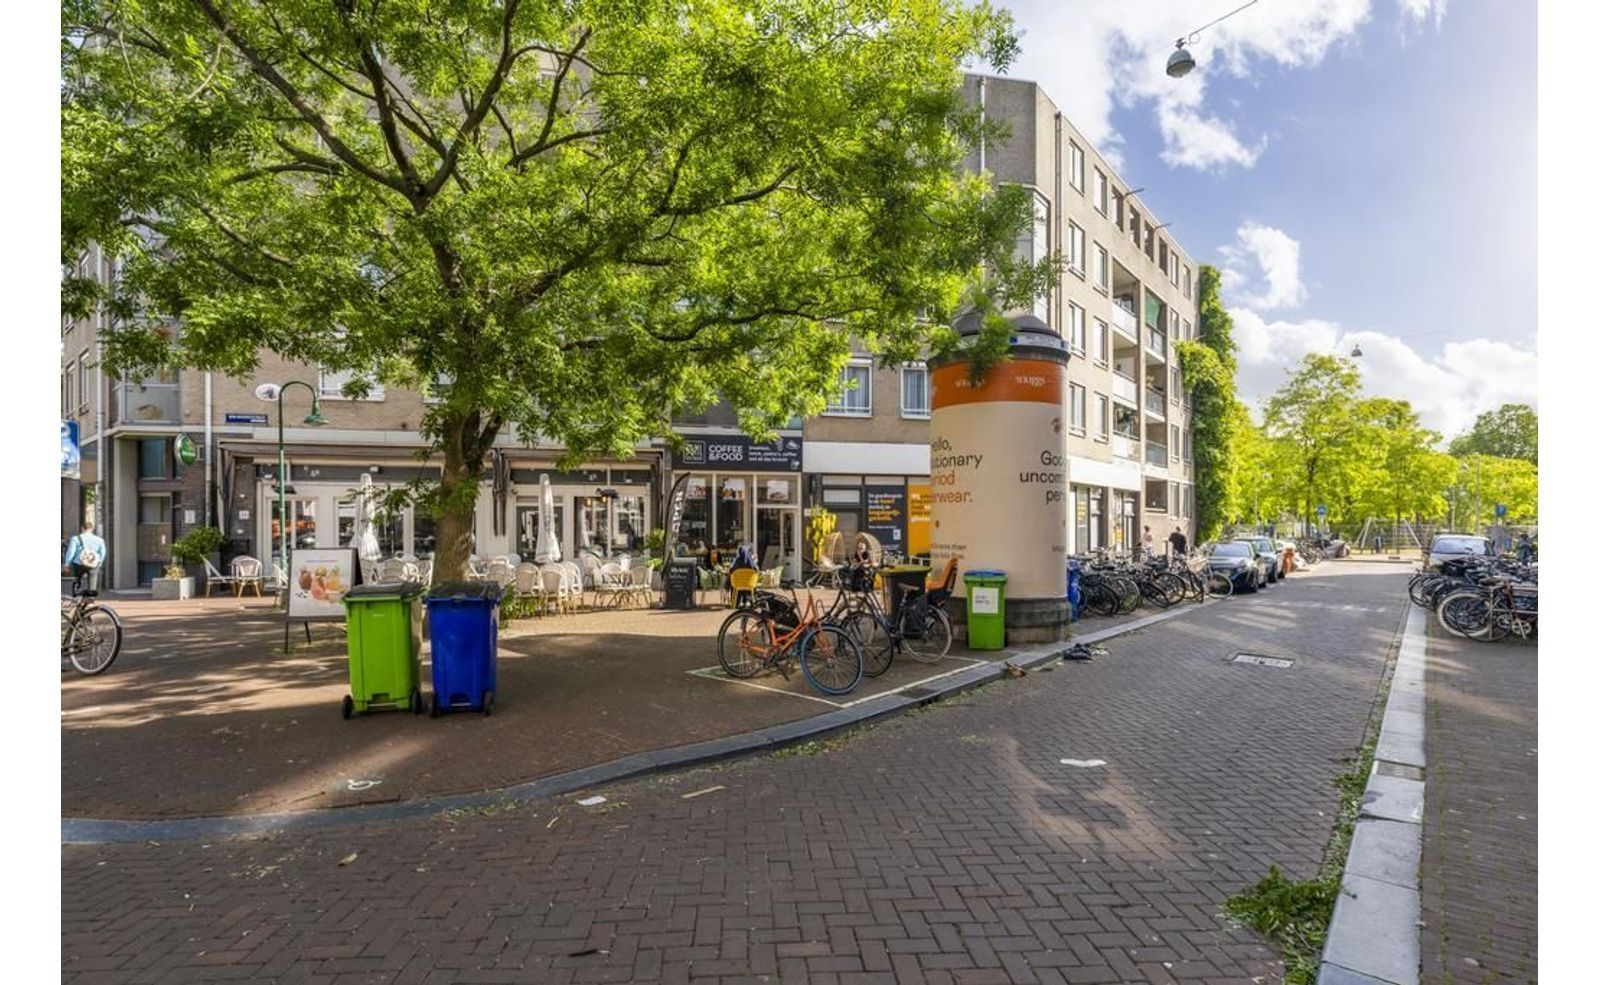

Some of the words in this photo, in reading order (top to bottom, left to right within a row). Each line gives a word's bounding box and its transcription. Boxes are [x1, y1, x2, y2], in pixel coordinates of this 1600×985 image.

[708, 445, 743, 453] COFFEE
[708, 453, 743, 461] &FOOD
[672, 491, 684, 533] OPEN
